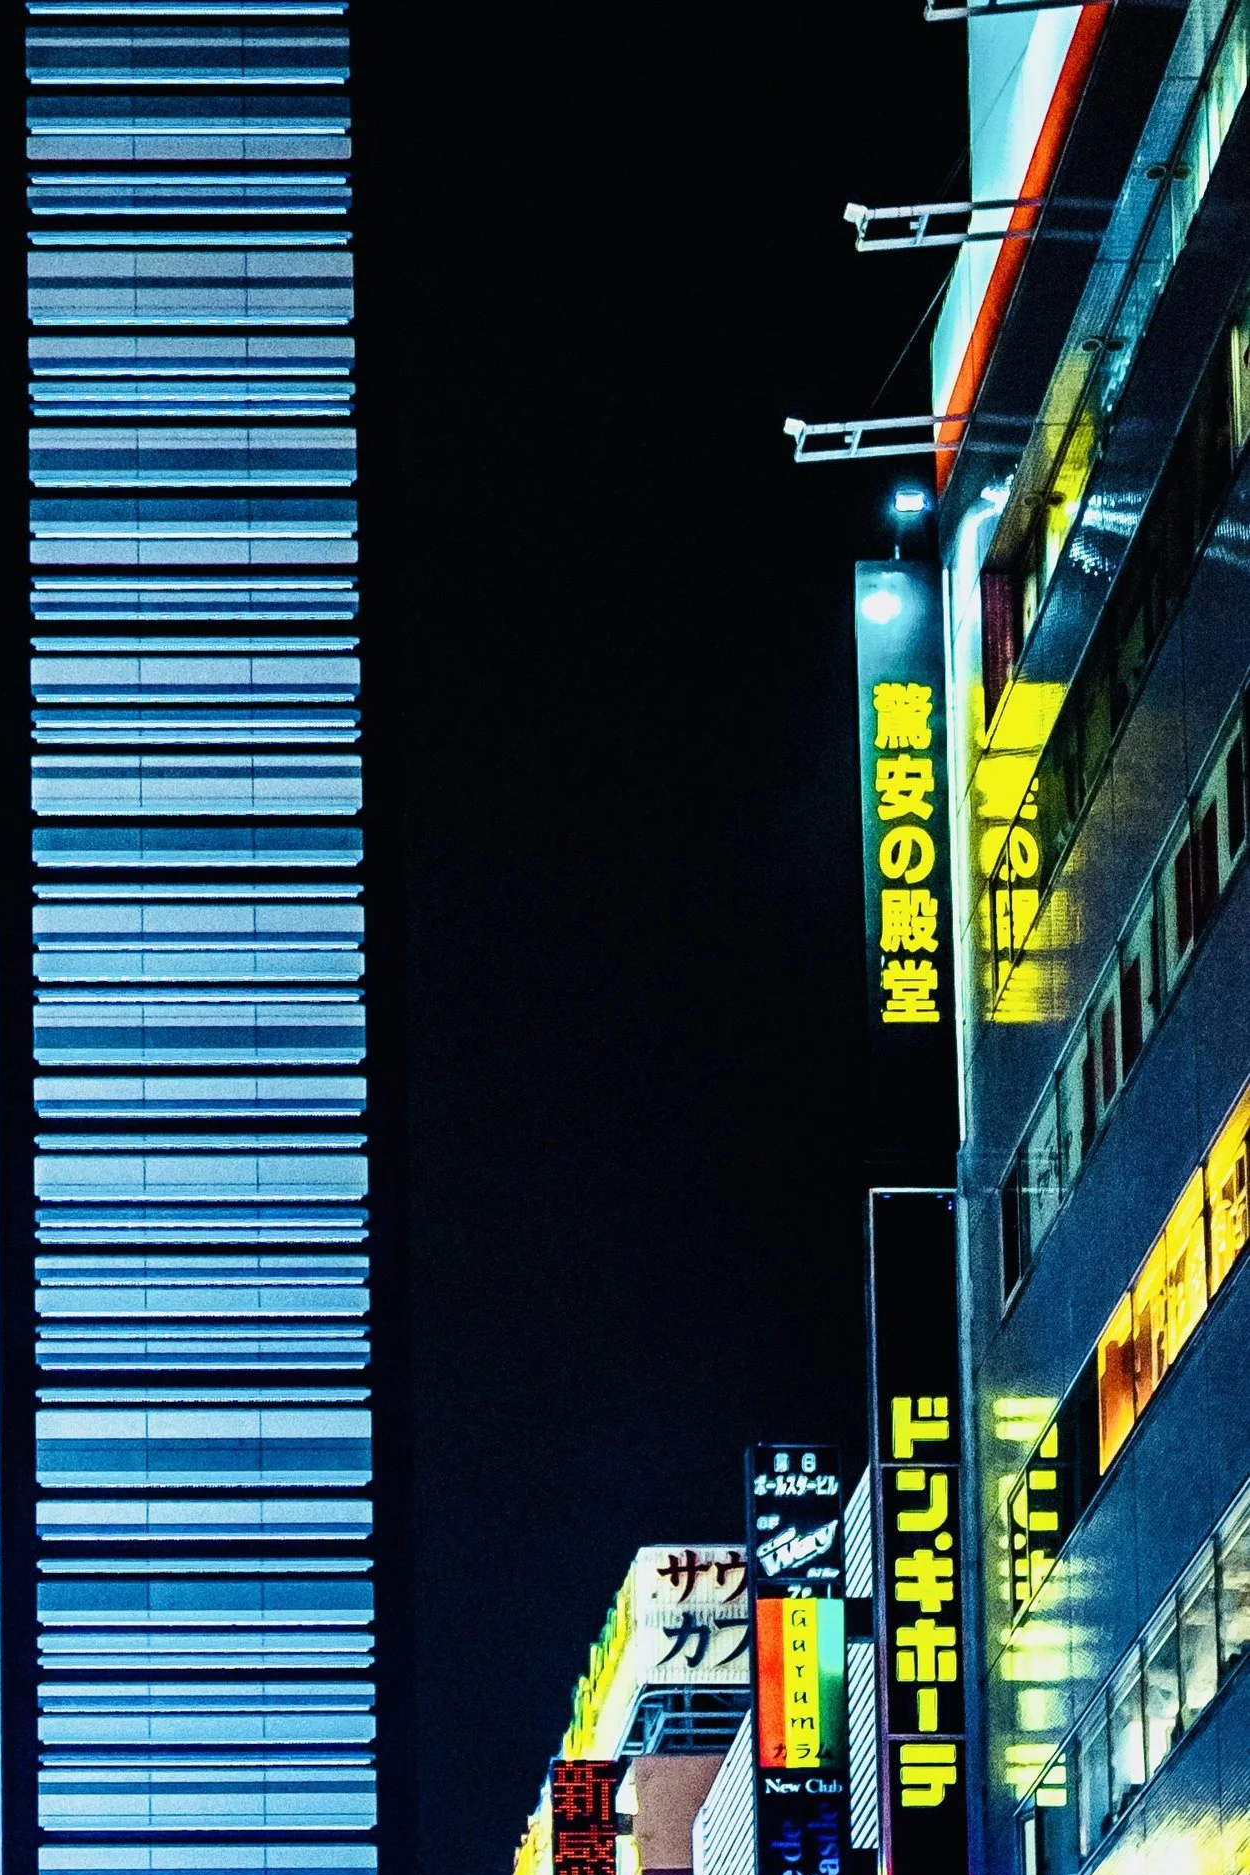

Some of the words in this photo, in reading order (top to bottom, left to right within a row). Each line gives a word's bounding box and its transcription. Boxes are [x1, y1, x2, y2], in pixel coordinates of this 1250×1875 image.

[873, 682, 940, 1023] 驚安の殿堂
[891, 1397, 957, 1807] ドン・キホーテ
[764, 1778, 801, 1794] New
[805, 1778, 843, 1793] Club
